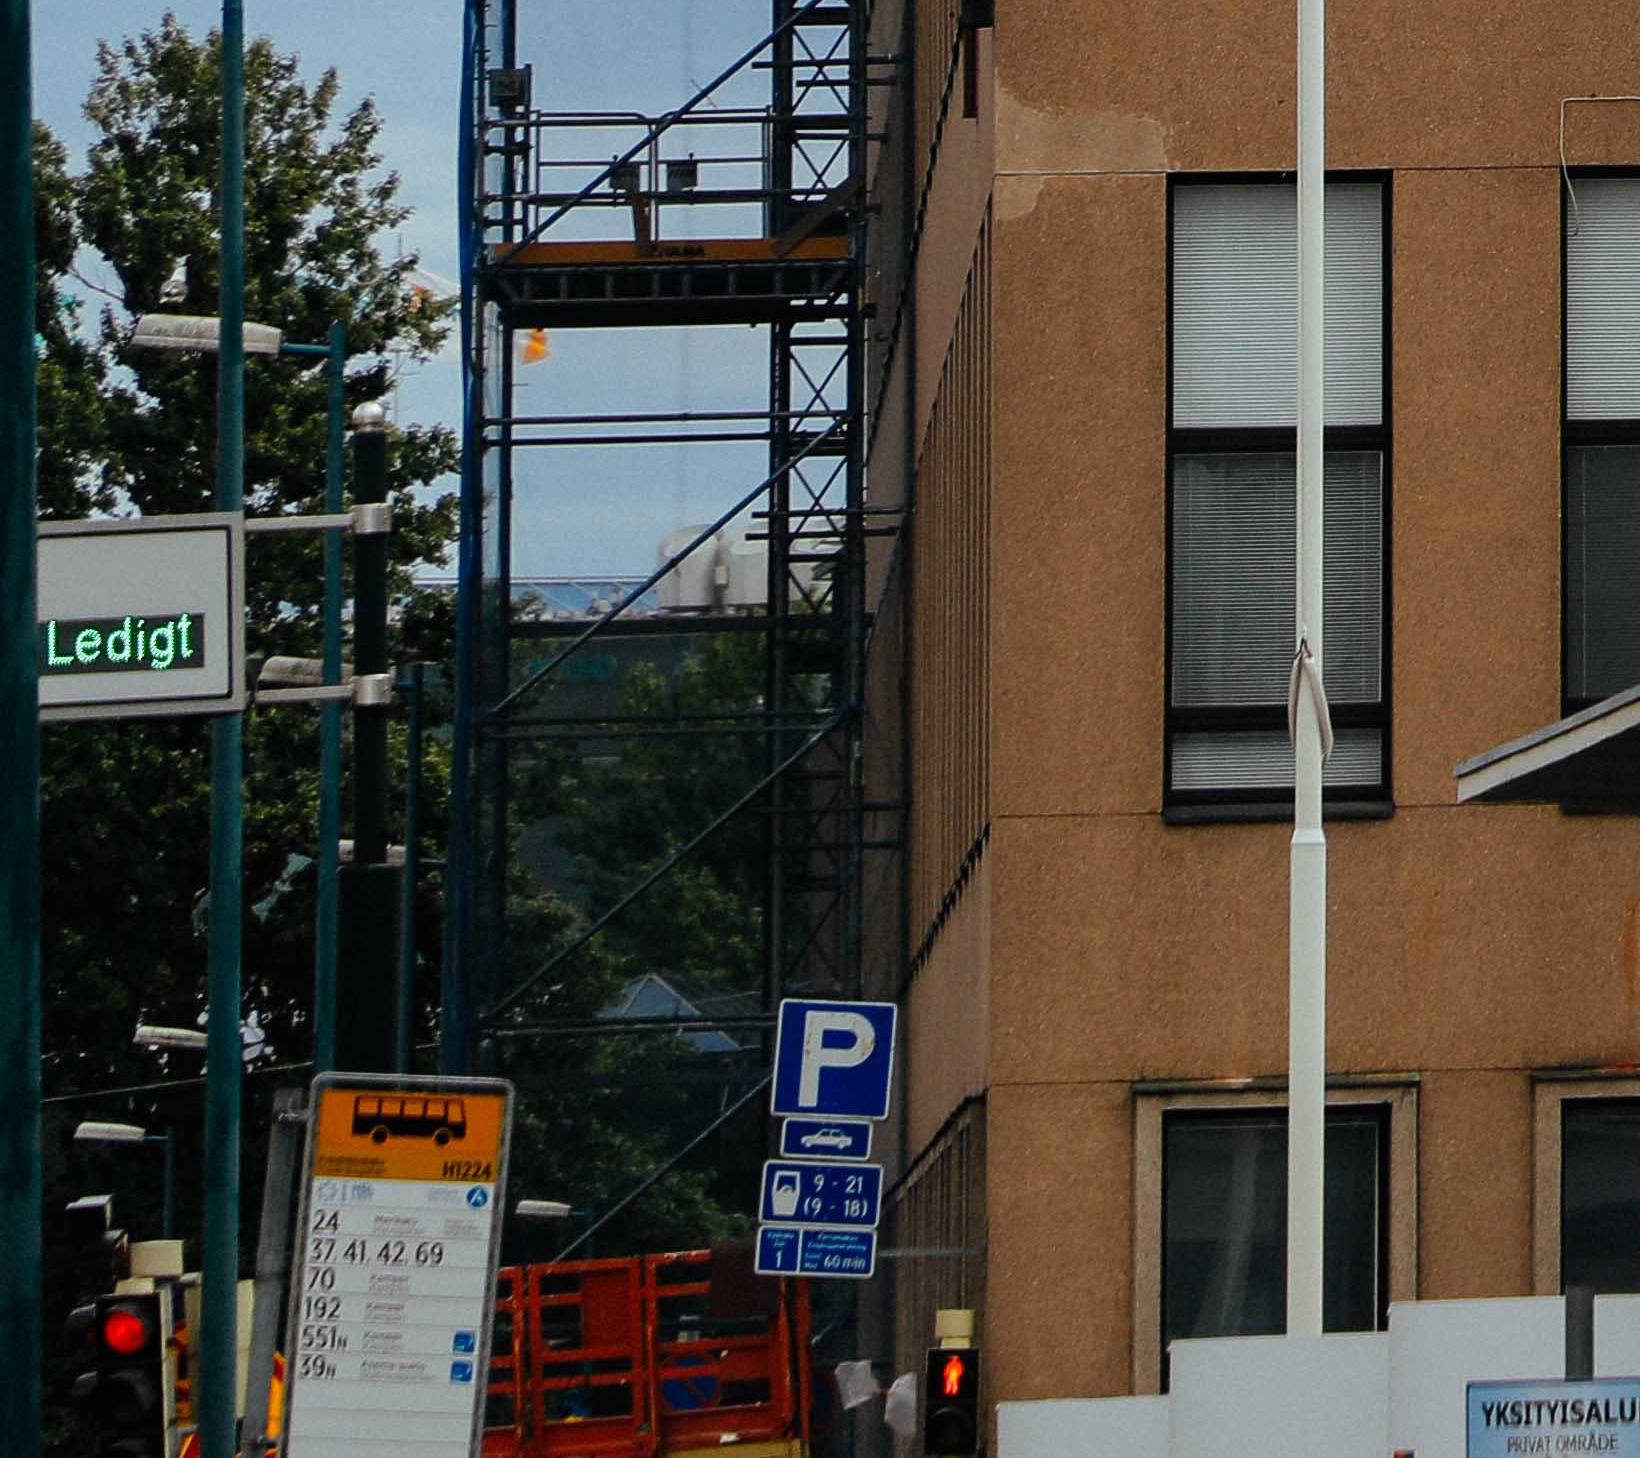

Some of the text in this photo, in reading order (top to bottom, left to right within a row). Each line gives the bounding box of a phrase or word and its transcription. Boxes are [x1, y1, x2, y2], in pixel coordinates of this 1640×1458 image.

[48, 613, 195, 670] Ledigt
[798, 1009, 876, 1107] P
[813, 1174, 825, 1193] 9
[845, 1175, 864, 1194] 21
[313, 1209, 340, 1233] 24
[415, 1242, 444, 1267] 69
[307, 1267, 336, 1291] 70
[304, 1296, 342, 1322] 192
[1507, 1430, 1620, 1454] PRIVAT OMRÅDE
